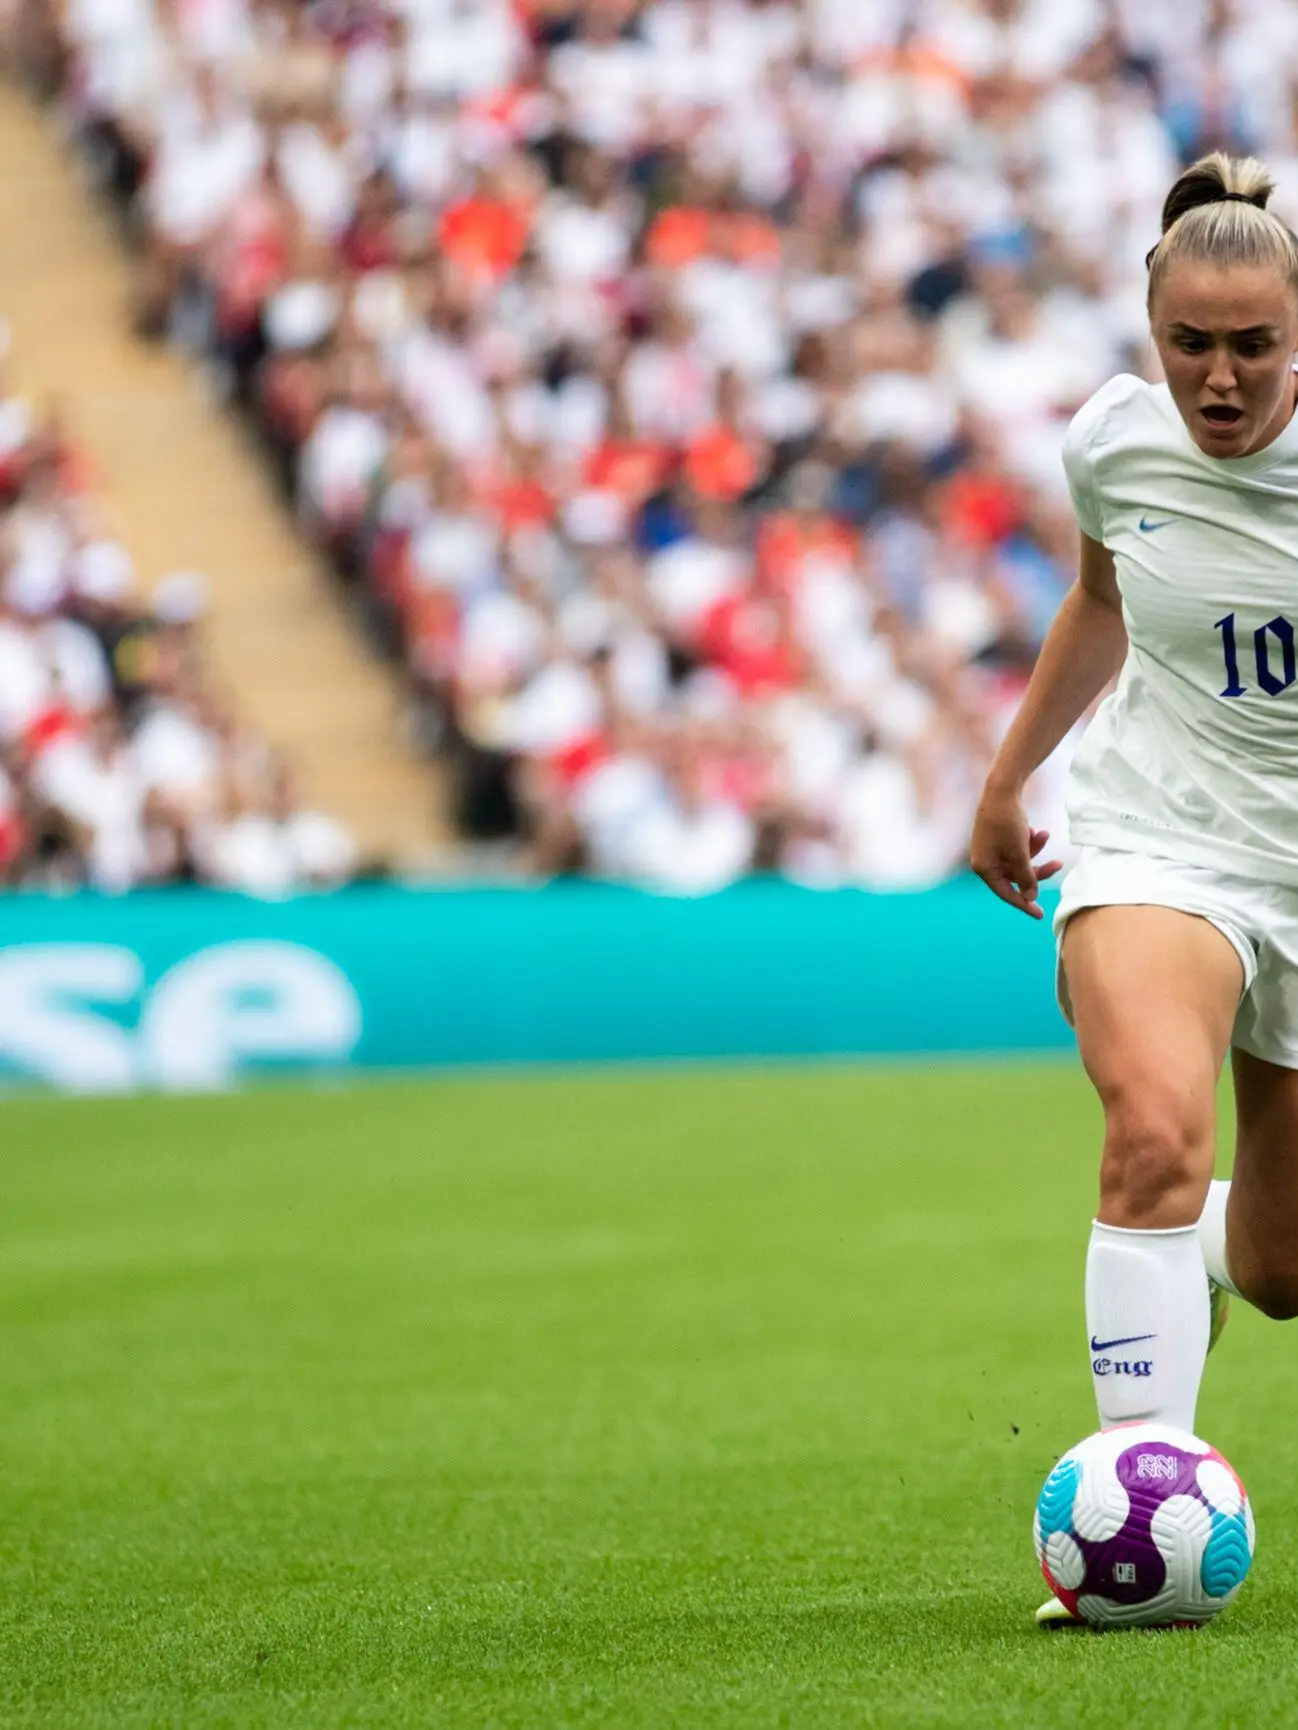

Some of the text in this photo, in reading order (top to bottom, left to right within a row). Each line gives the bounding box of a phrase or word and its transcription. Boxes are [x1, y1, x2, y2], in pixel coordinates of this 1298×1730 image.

[1214, 612, 1297, 697] 10
[0, 938, 364, 1098] se
[1092, 1358, 1154, 1377] Eng
